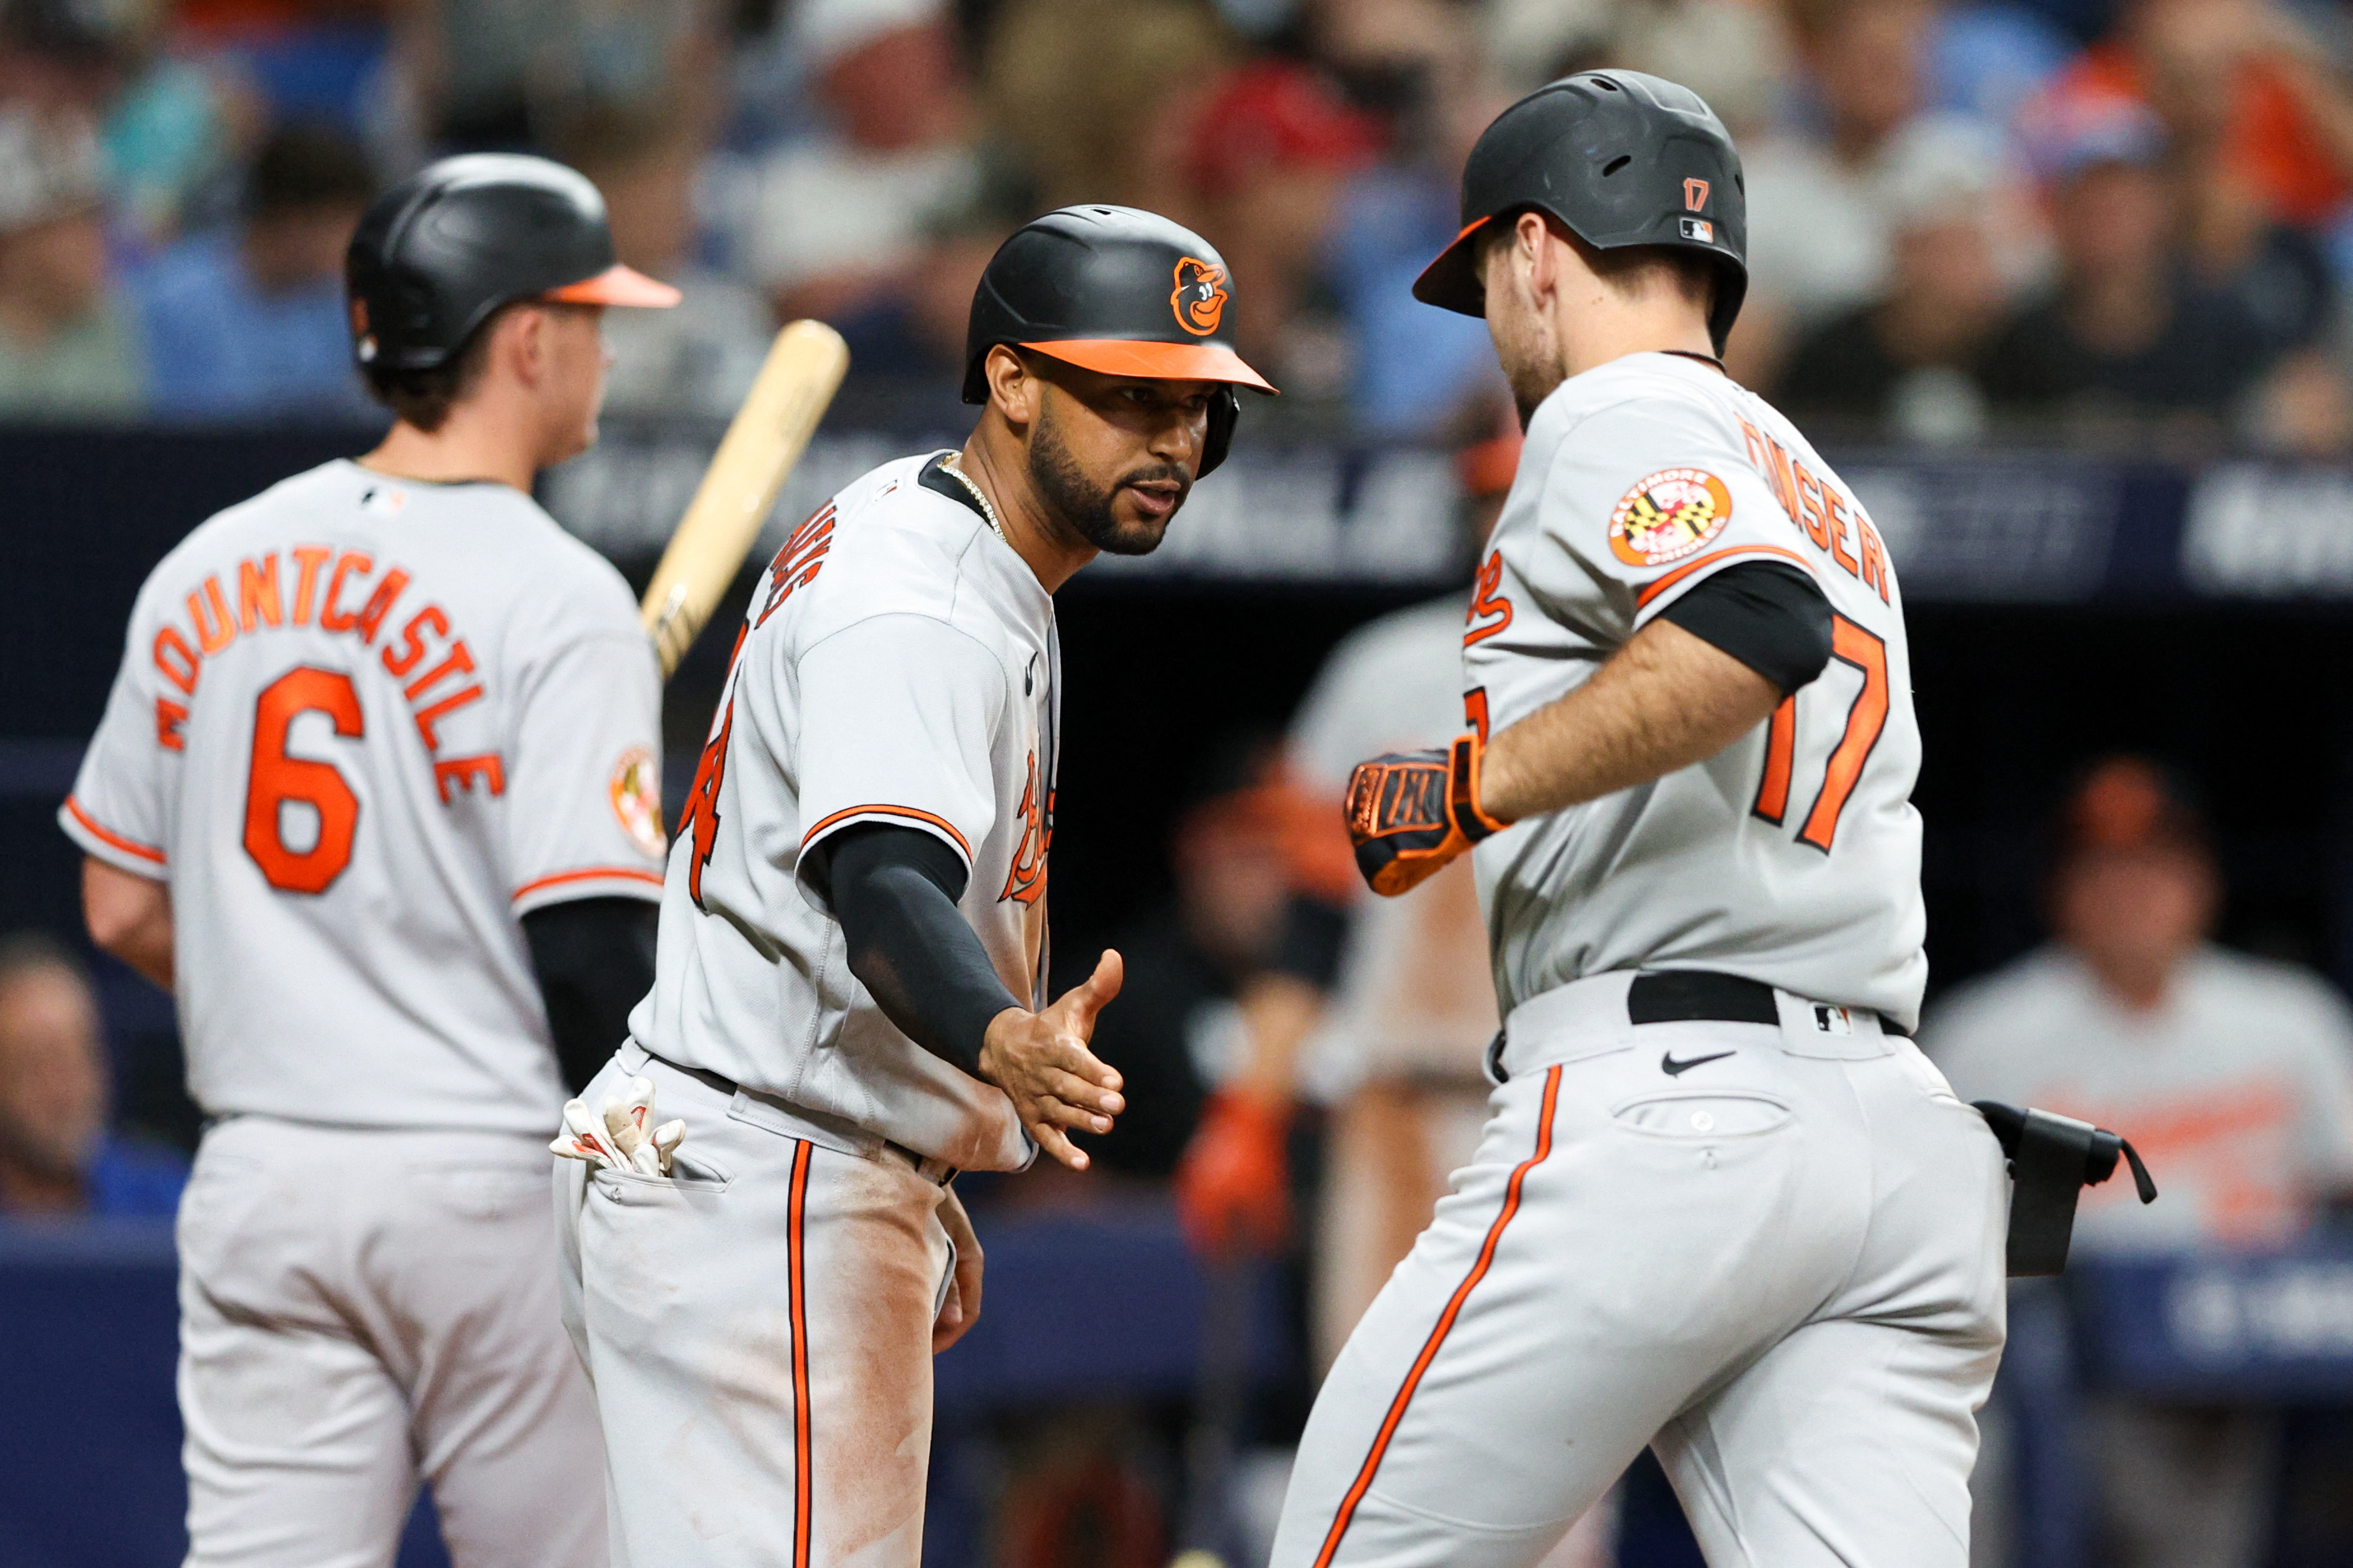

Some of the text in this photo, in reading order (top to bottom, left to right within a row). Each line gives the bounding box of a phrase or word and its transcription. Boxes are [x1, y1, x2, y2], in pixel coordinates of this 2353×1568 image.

[1683, 177, 1709, 212] 17
[1609, 469, 1711, 538] BALTIMORE
[1645, 516, 1727, 566] ORIOLES
[1734, 411, 1891, 608] OWSER
[152, 545, 505, 806] MOUNTCASTLE
[243, 665, 364, 895] 6
